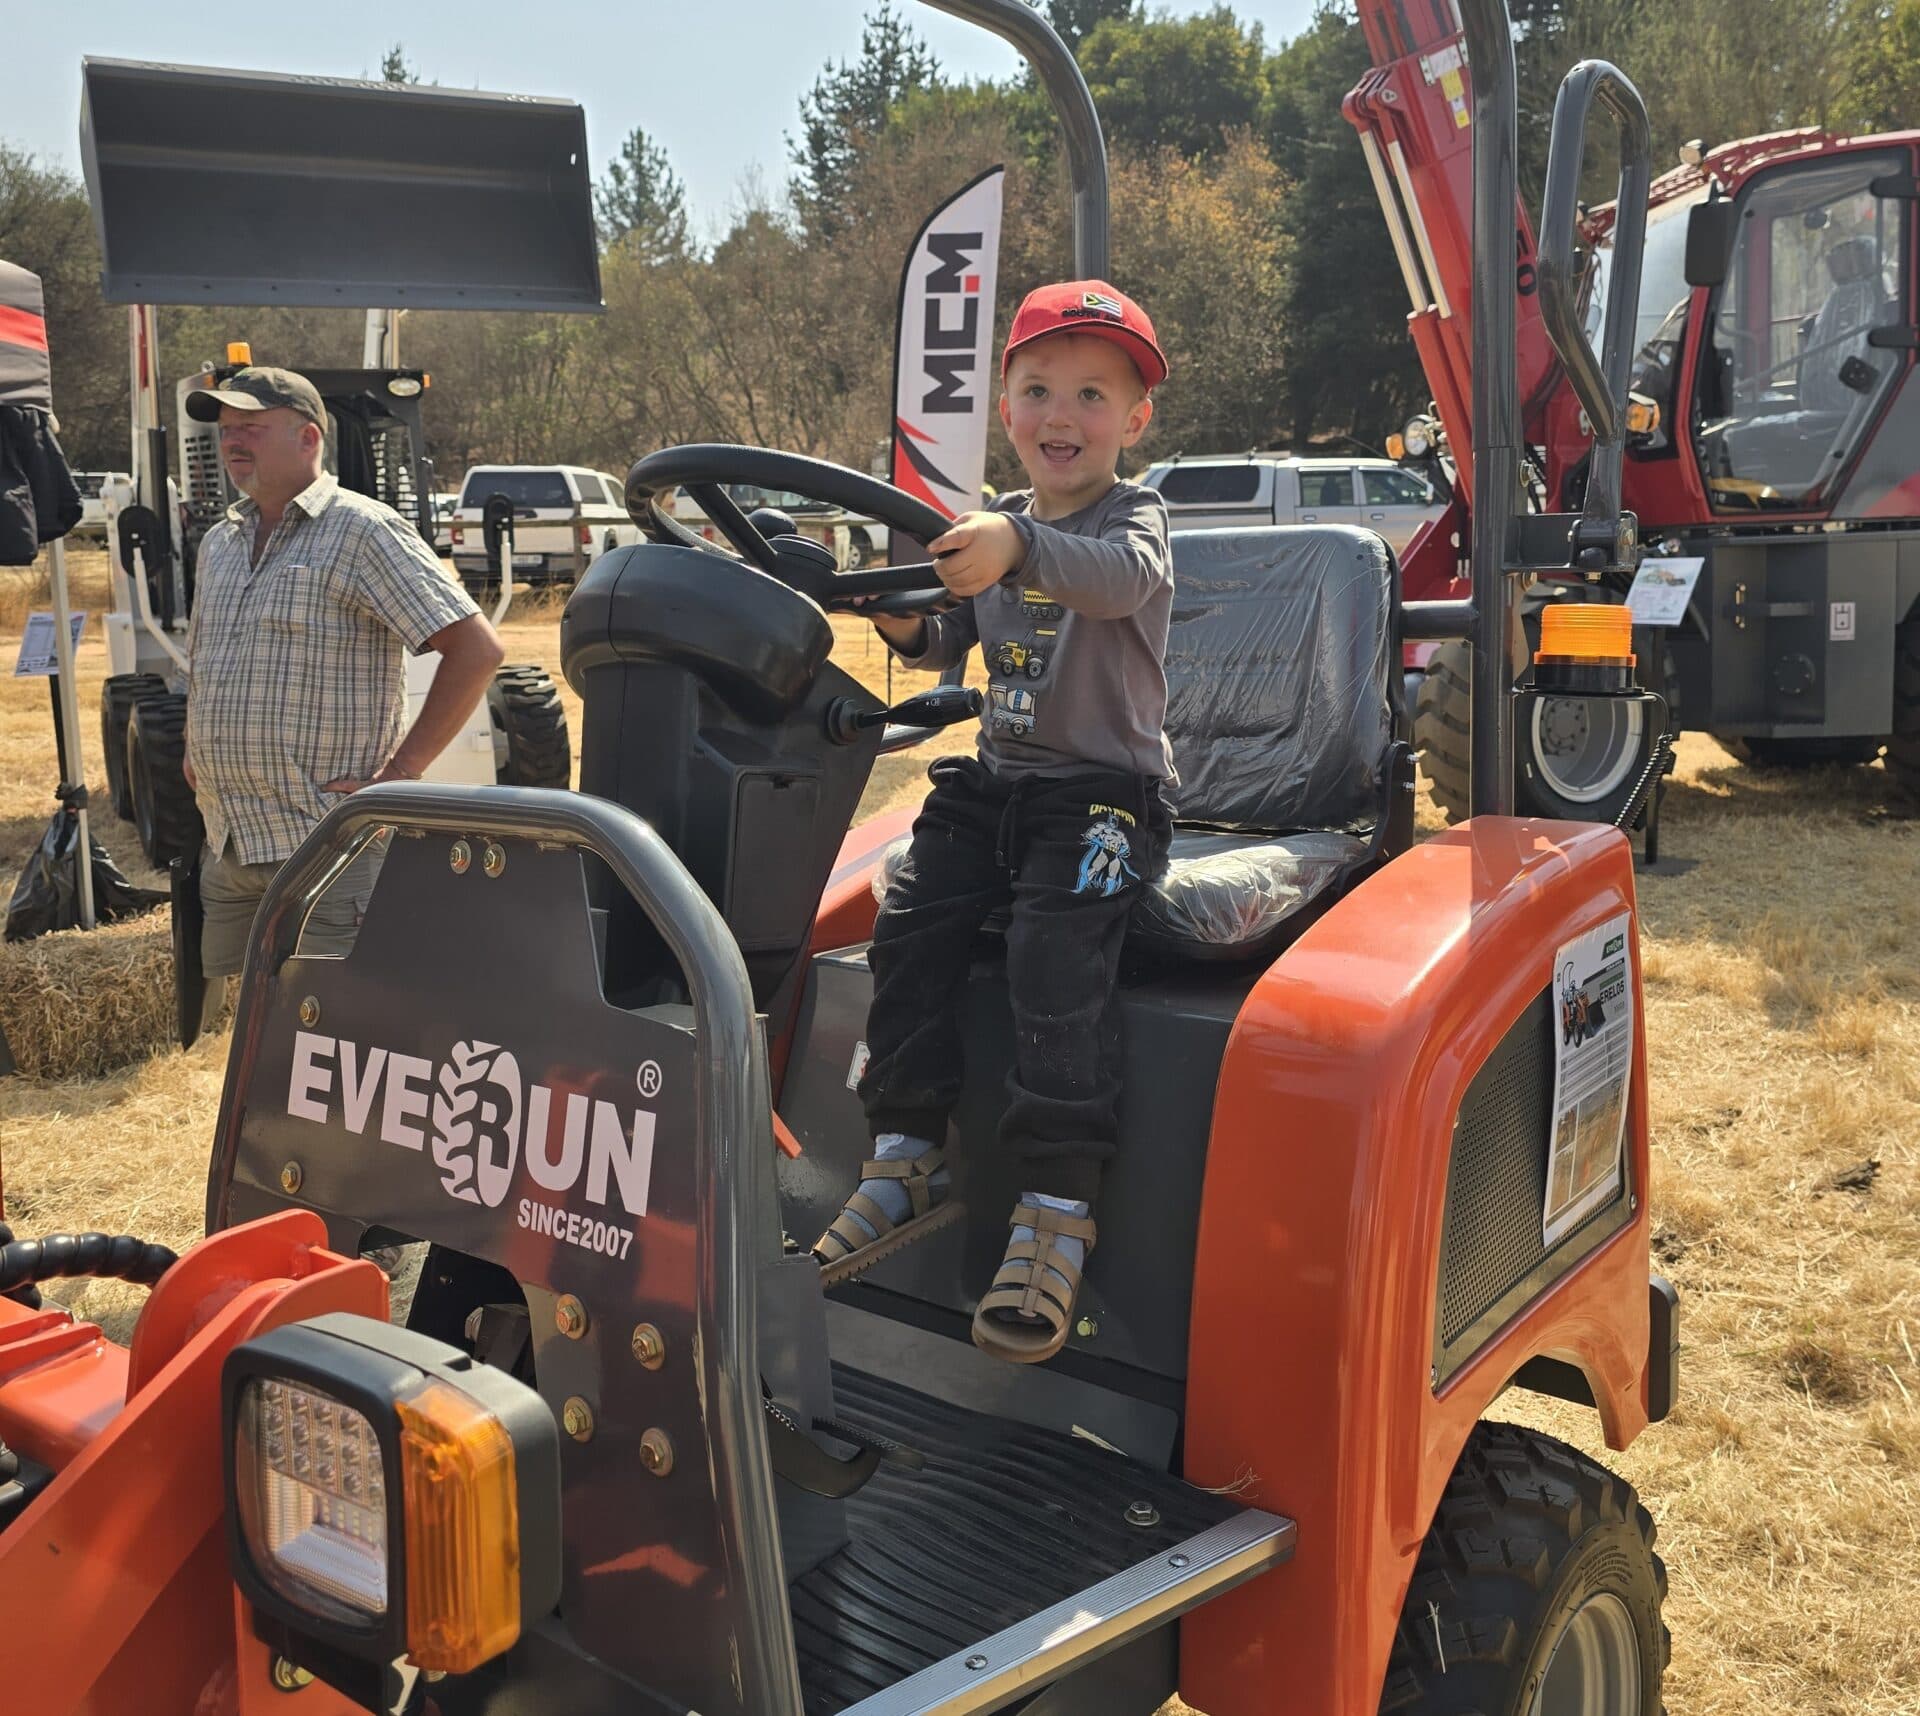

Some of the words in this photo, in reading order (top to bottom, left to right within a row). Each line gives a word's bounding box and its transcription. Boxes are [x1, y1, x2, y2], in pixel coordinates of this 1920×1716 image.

[922, 232, 983, 413] MCM
[288, 1031, 657, 1217] EVERUN
[517, 1198, 634, 1261] SINCE2007
